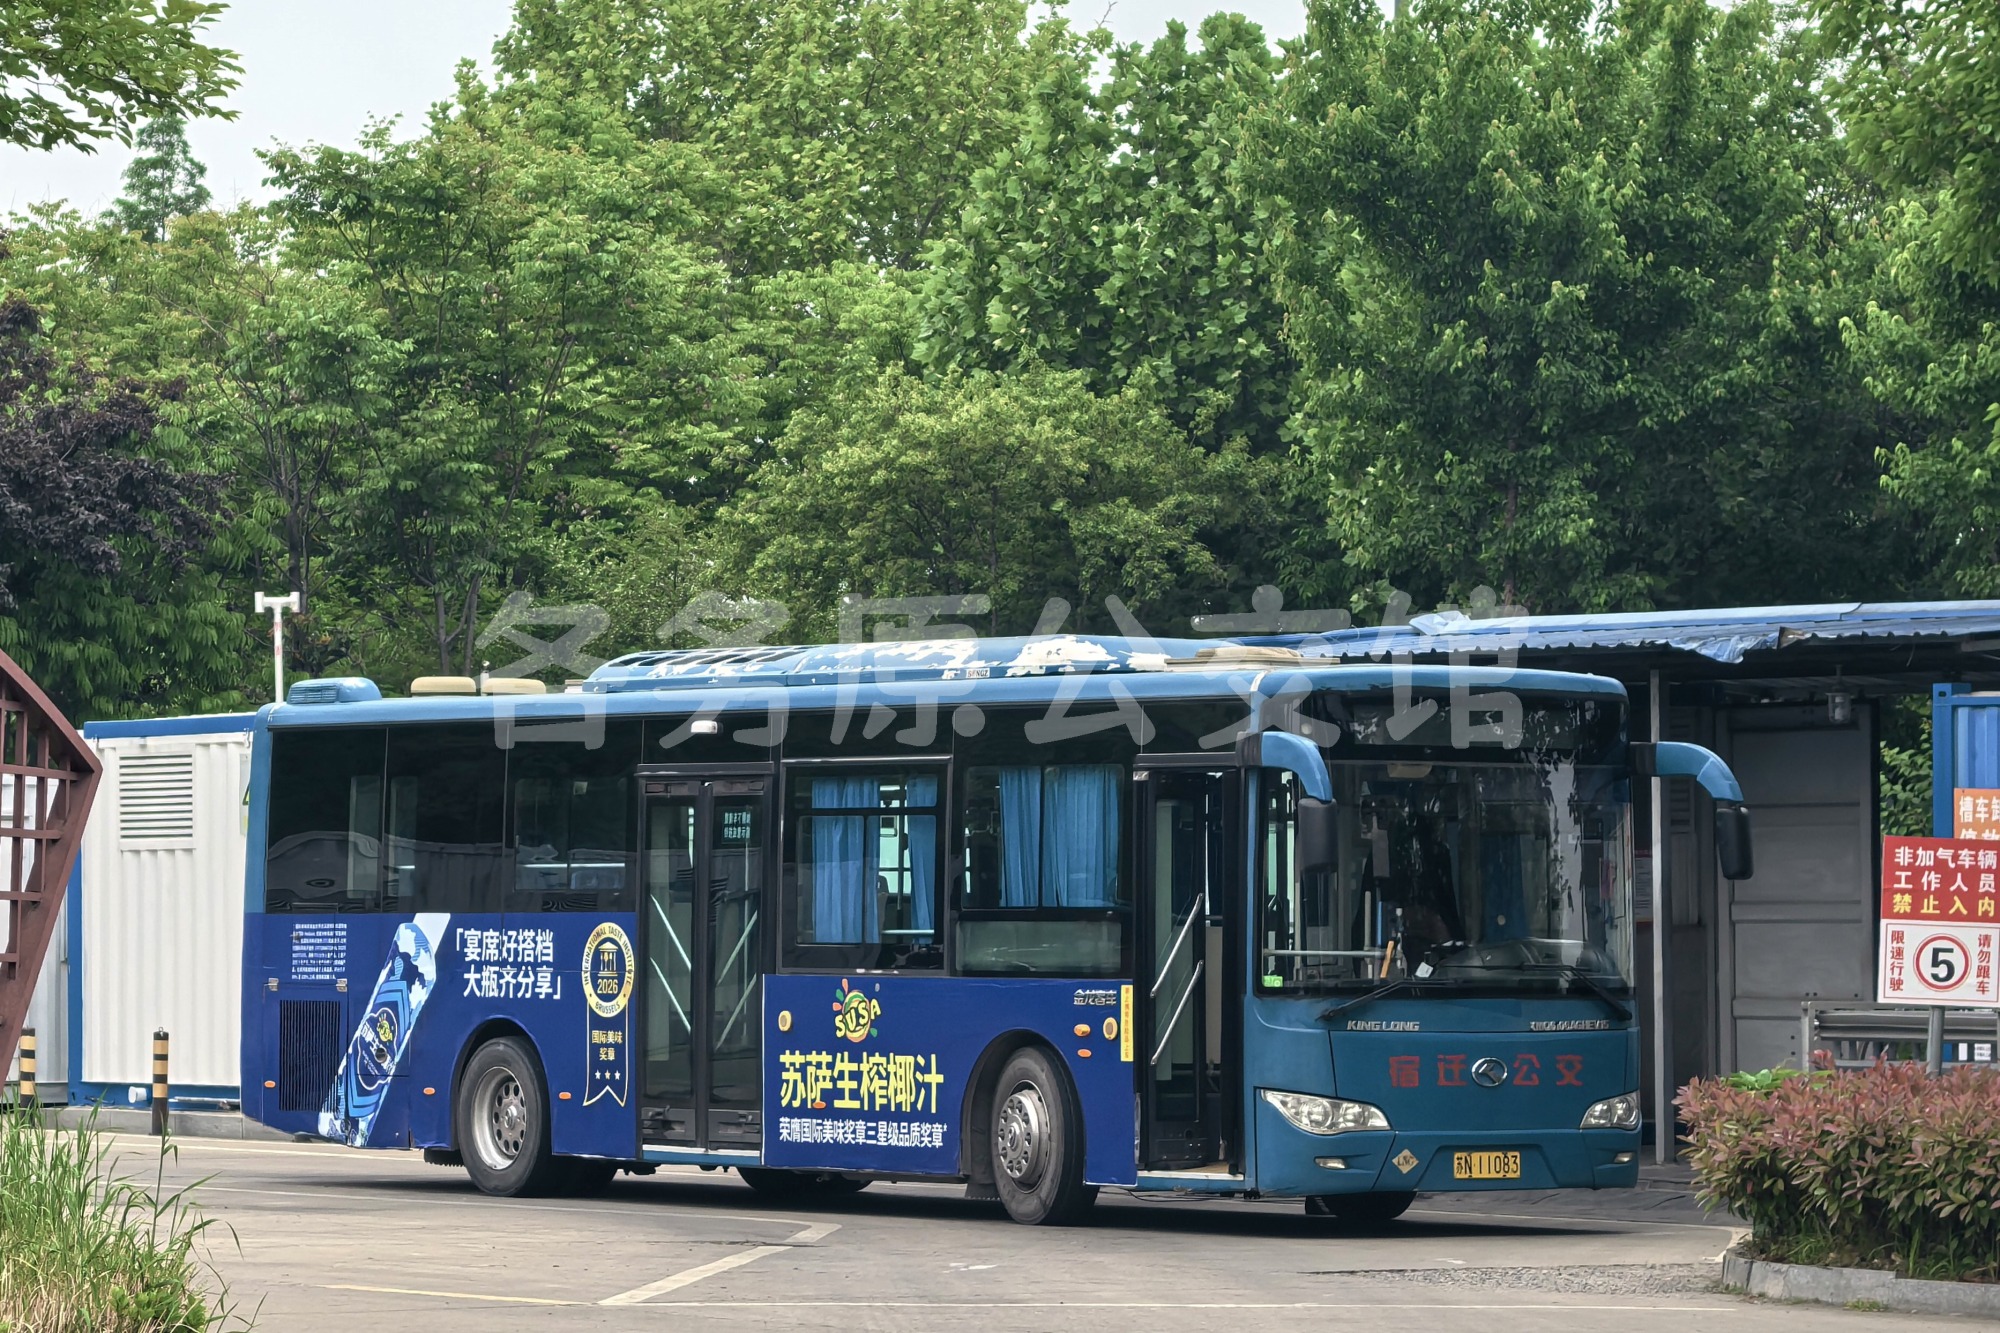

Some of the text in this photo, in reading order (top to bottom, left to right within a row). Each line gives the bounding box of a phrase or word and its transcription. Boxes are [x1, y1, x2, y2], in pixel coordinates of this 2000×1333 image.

[1894, 846, 1998, 870] 非加气车辆
[1893, 870, 1996, 893] 工作人员
[1892, 893, 1995, 917] 禁止入内
[608, 925, 624, 940] TASTE
[622, 940, 632, 985] INSTITTE
[1889, 930, 1905, 992] 限速行驶
[1930, 947, 1956, 983] 5
[1976, 934, 1992, 995] 请勿跟车
[597, 979, 618, 994] 2026
[595, 1001, 621, 1015] BRUSSELS
[592, 1029, 623, 1044] 国际美味
[1346, 1020, 1420, 1031] KING LONG
[599, 1047, 615, 1061] 奖章
[779, 1050, 945, 1114] 苏萨生榨椰汁
